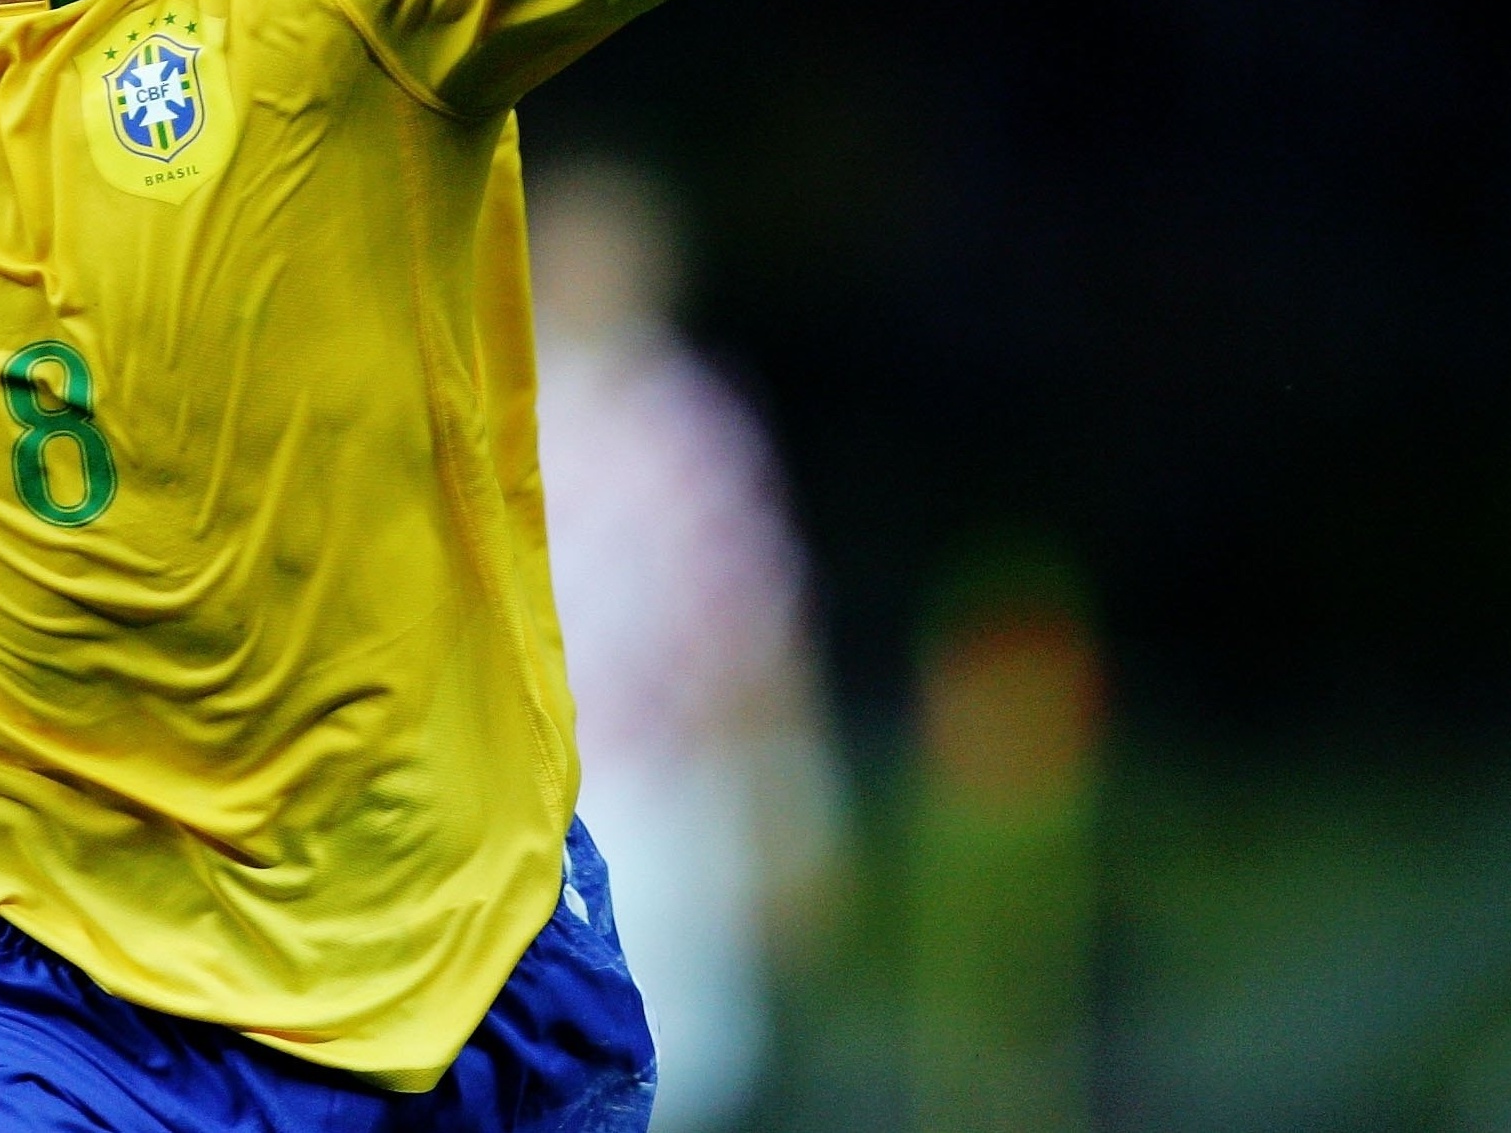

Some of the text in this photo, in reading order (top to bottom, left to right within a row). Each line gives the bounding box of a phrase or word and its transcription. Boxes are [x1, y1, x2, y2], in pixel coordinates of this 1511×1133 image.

[136, 83, 170, 103] CBF
[144, 165, 200, 186] BRASIL
[2, 340, 118, 528] 8
